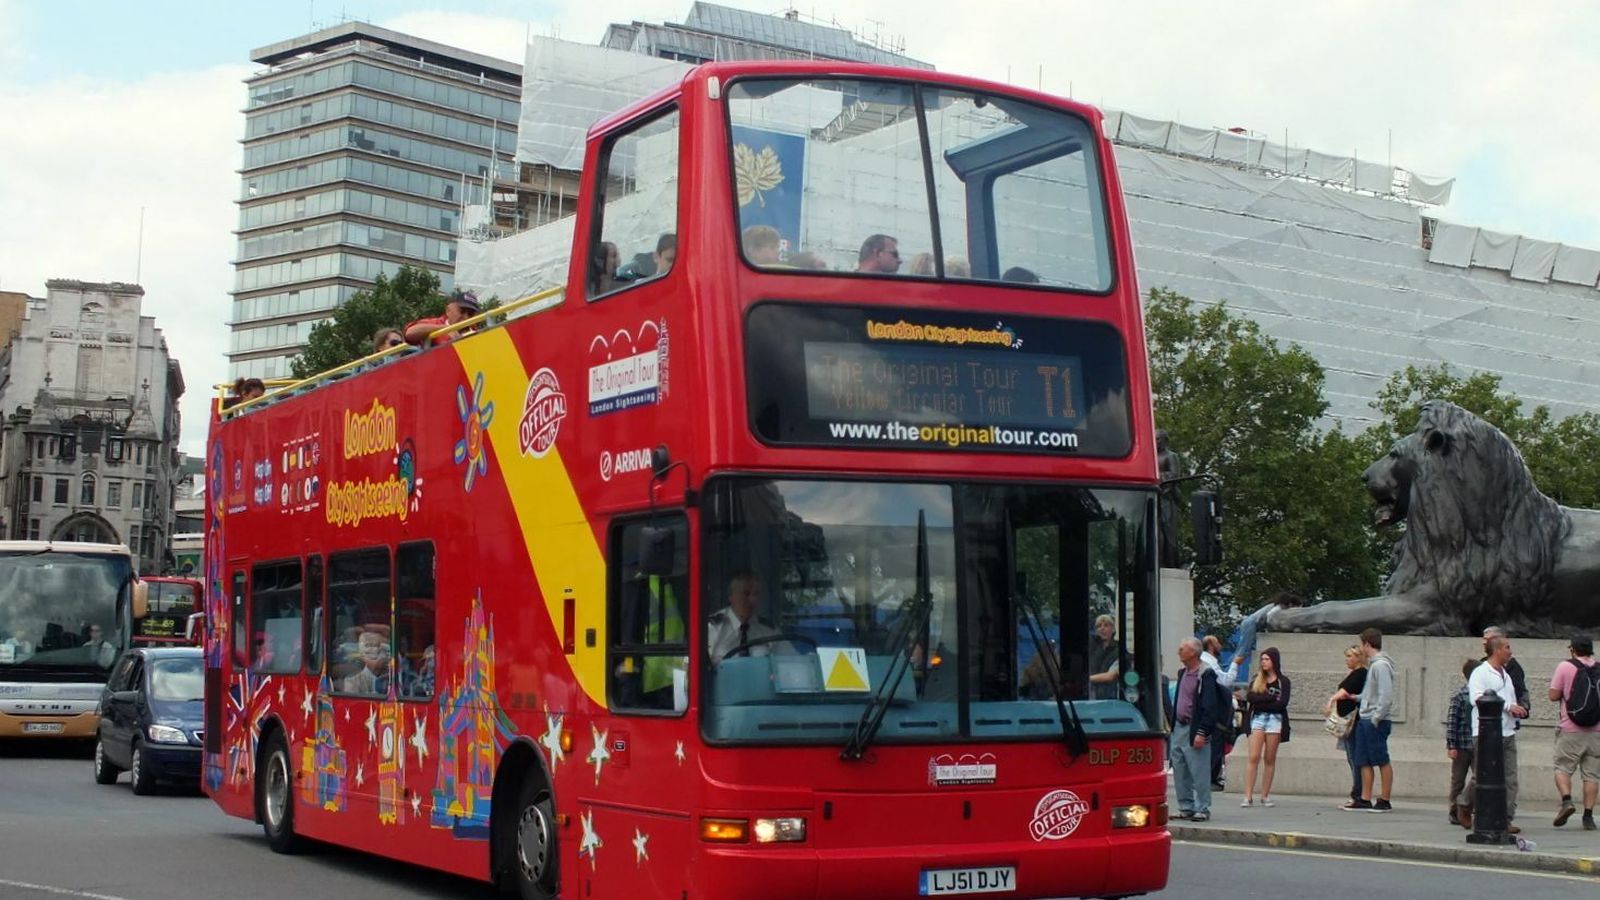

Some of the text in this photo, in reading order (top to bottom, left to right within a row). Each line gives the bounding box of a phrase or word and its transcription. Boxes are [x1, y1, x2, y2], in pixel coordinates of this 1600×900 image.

[867, 320, 924, 340] London
[592, 357, 655, 395] The Original Tour
[873, 359, 959, 386] Original
[967, 362, 1021, 389] Tour
[591, 392, 656, 414] London Sightseeing
[975, 389, 1013, 417] Tour
[1037, 366, 1077, 417] T1
[344, 397, 396, 460] London
[521, 397, 566, 448] OFFICIAL
[537, 422, 556, 450] TOUR
[829, 421, 1079, 448] www.theoriginaltour.com
[614, 448, 652, 474] ARRIVA
[1088, 747, 1153, 765] DLP 253
[1034, 803, 1086, 835] OFFICIAL
[1056, 816, 1078, 835] TOUR
[933, 870, 1010, 891] LJ51 DJY
